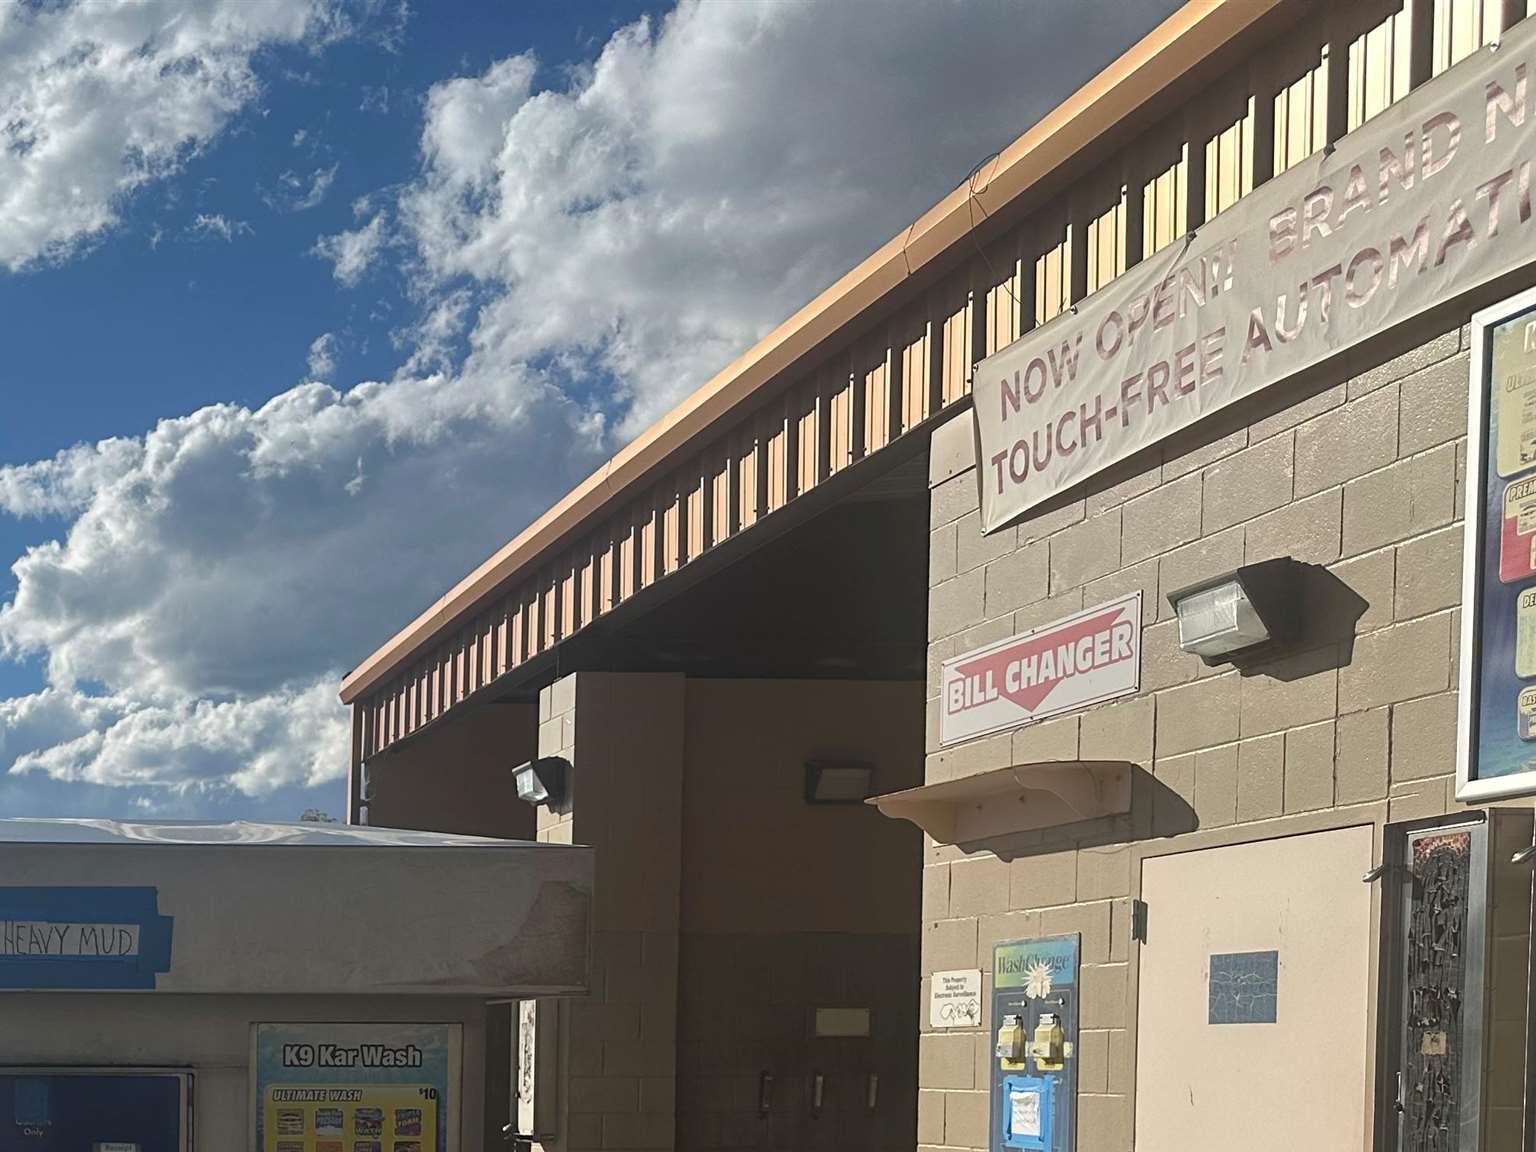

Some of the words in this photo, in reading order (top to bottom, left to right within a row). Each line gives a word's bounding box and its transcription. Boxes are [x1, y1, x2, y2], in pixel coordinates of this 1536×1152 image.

[1000, 330, 1083, 422] NOW
[1095, 239, 1238, 361] OPEN!!
[1268, 111, 1462, 266] BRAND
[1484, 62, 1536, 144] N
[991, 325, 1226, 495] TOUCH-FREE
[948, 669, 999, 715] BILL
[1005, 620, 1134, 694] CHANGER
[3, 920, 70, 956] HEAVY
[78, 926, 133, 958] MUD
[282, 1044, 314, 1068] K9
[317, 1044, 359, 1068] Kar
[361, 1044, 423, 1068] Wash
[272, 1088, 326, 1101] ULTIMATE
[328, 1088, 363, 1101] WASH
[23, 1127, 44, 1137] Only
